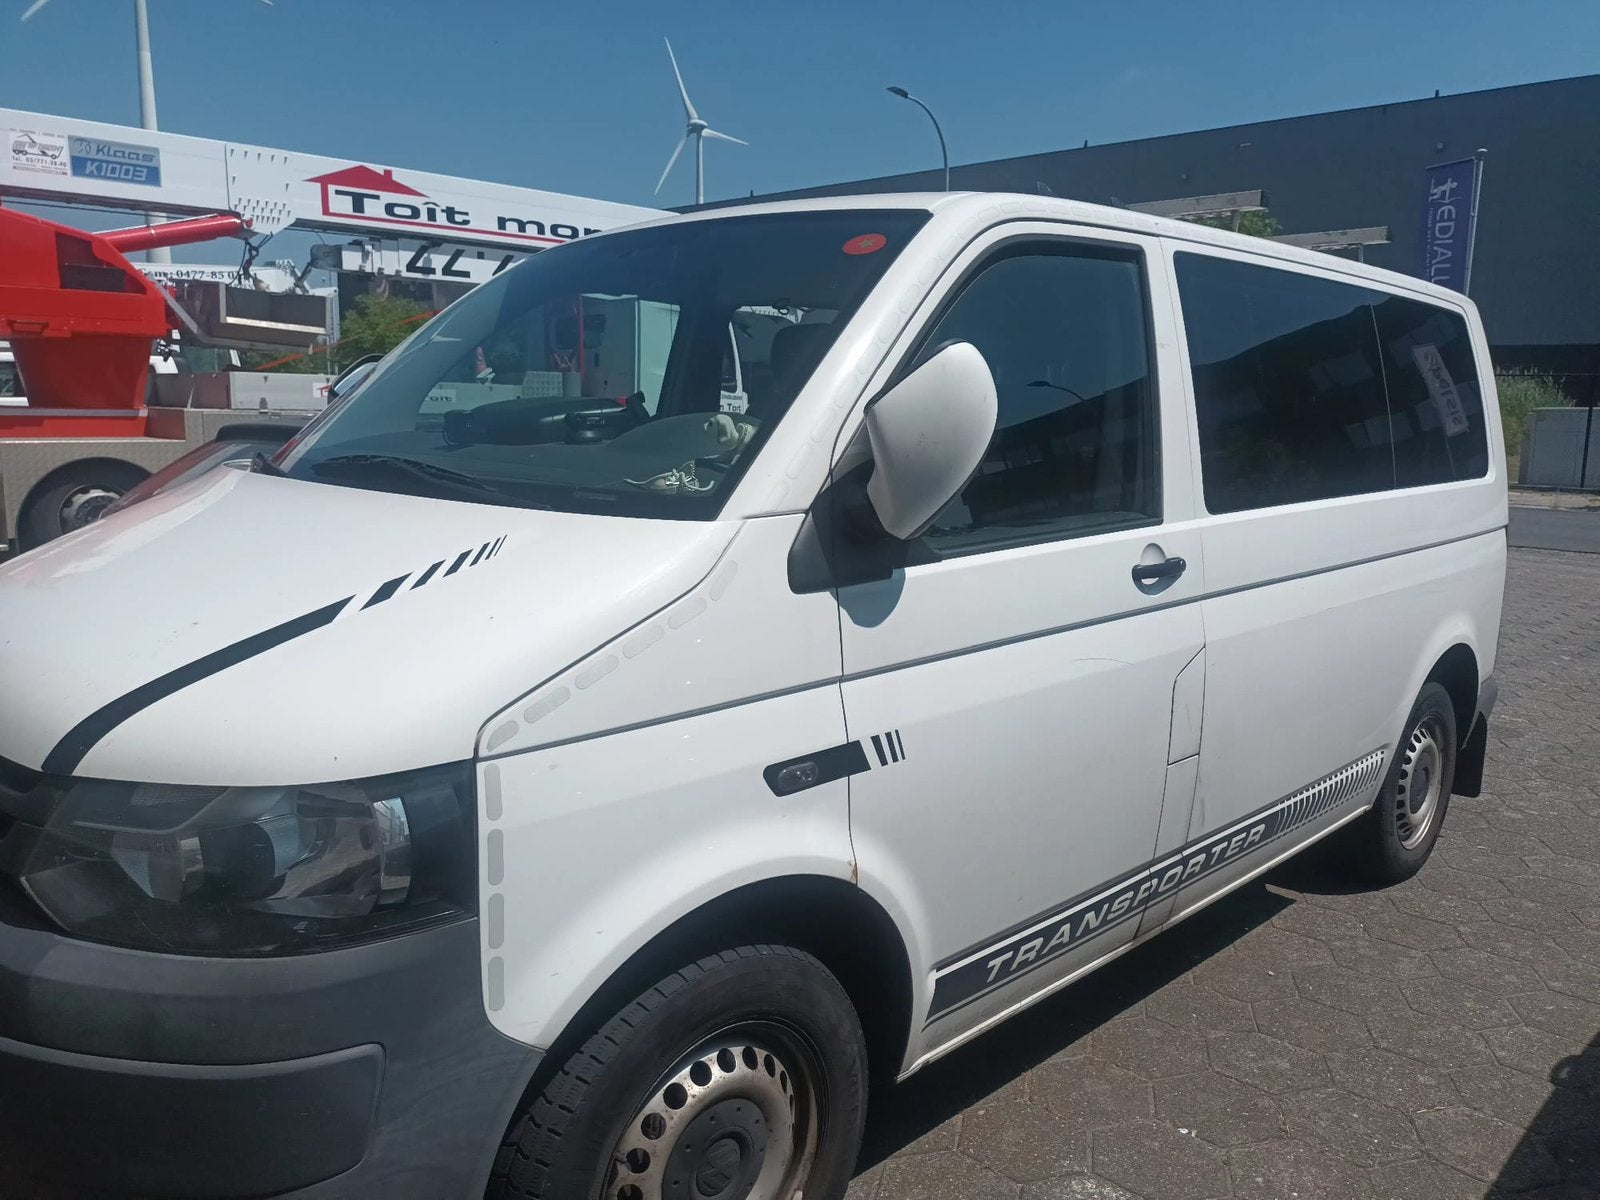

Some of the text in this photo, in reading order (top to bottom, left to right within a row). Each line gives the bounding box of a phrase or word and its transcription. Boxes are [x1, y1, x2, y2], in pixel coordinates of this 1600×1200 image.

[85, 161, 147, 181] K1003
[334, 189, 471, 226] Toît
[986, 823, 1266, 983] TRANSPORTER
